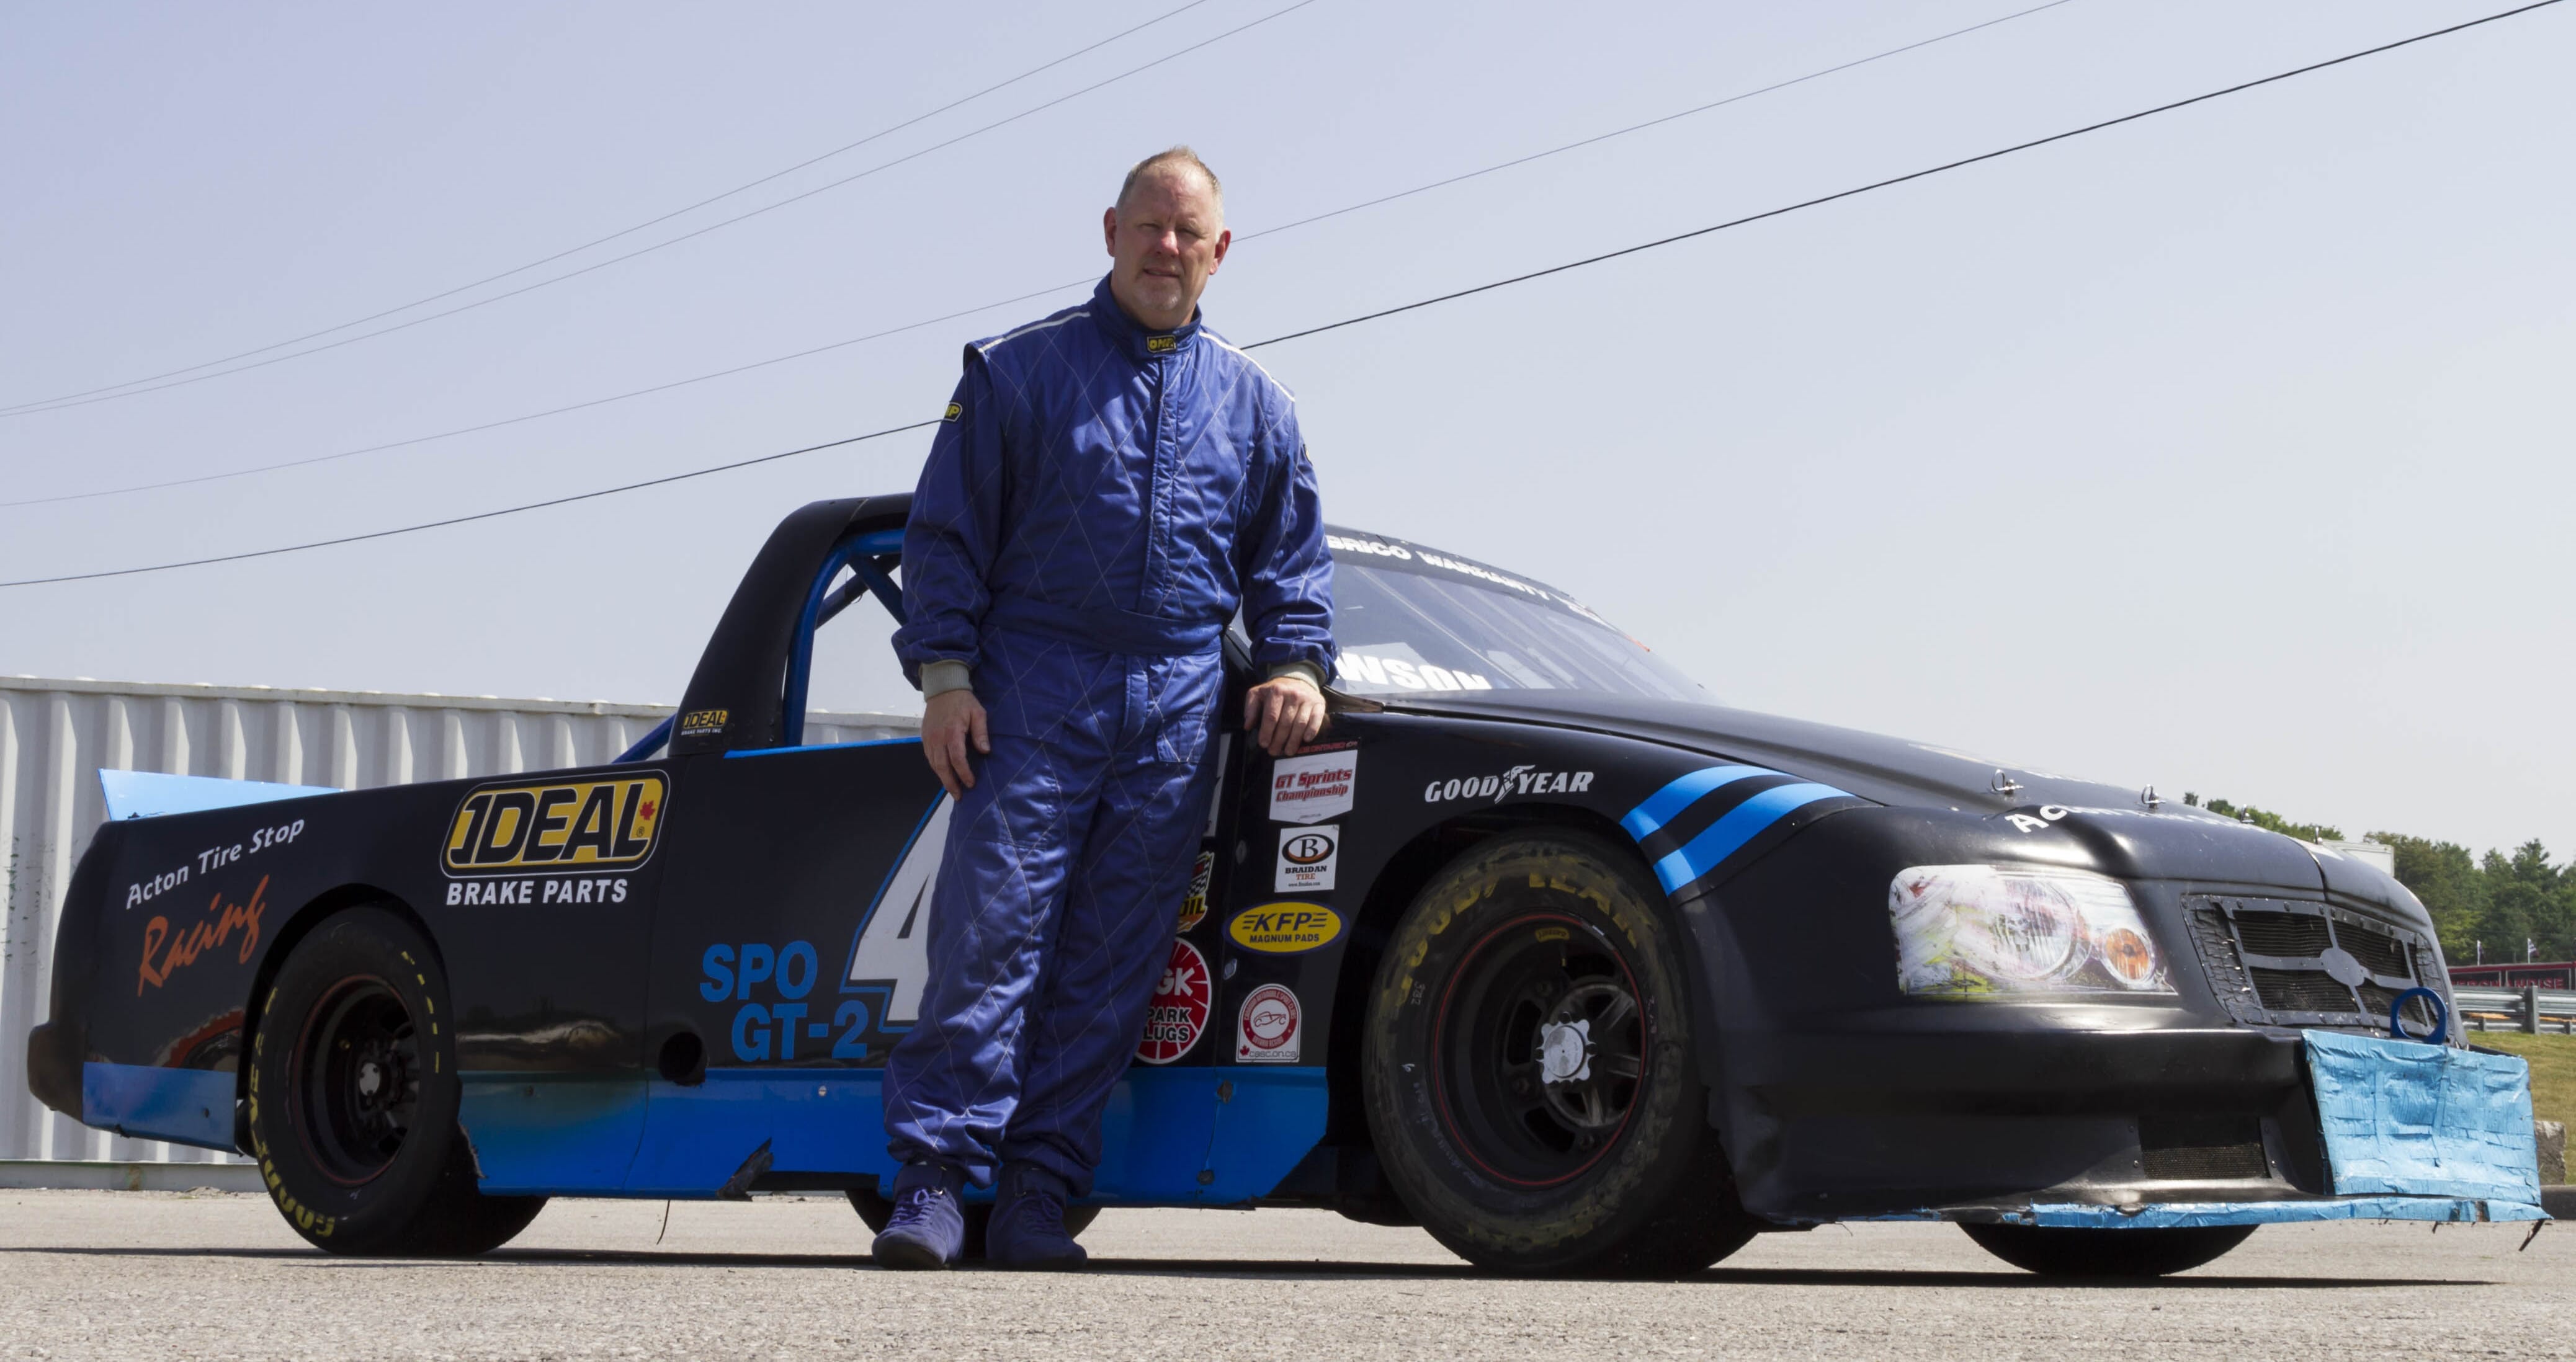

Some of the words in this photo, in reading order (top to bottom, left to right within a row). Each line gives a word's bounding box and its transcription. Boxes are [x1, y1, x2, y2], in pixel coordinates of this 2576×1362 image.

[1326, 535, 1411, 560] BRICO
[1334, 652, 1492, 691] WSON
[684, 711, 725, 728] IDEAL
[1275, 773, 1296, 790] GT
[1297, 768, 1353, 788] Sprints
[1276, 783, 1348, 802] Championship
[449, 783, 650, 865] IDEAL
[1299, 838, 1318, 858] B
[126, 866, 189, 910] Acton
[198, 843, 242, 875] Tire
[249, 819, 305, 854] Stop
[1285, 865, 1327, 874] BRAIDAN
[446, 881, 534, 906] BRAKE
[542, 878, 628, 904] PARTS
[1252, 912, 1312, 932] KFP
[138, 874, 270, 997] Racing
[1250, 934, 1292, 943] MAGNUM
[1295, 933, 1320, 942] PADS
[699, 940, 818, 1002] SPO
[1156, 967, 1195, 997] GK
[1147, 1007, 1191, 1023] PARK
[731, 999, 869, 1062] GT-2
[1142, 1025, 1189, 1041] LUGS
